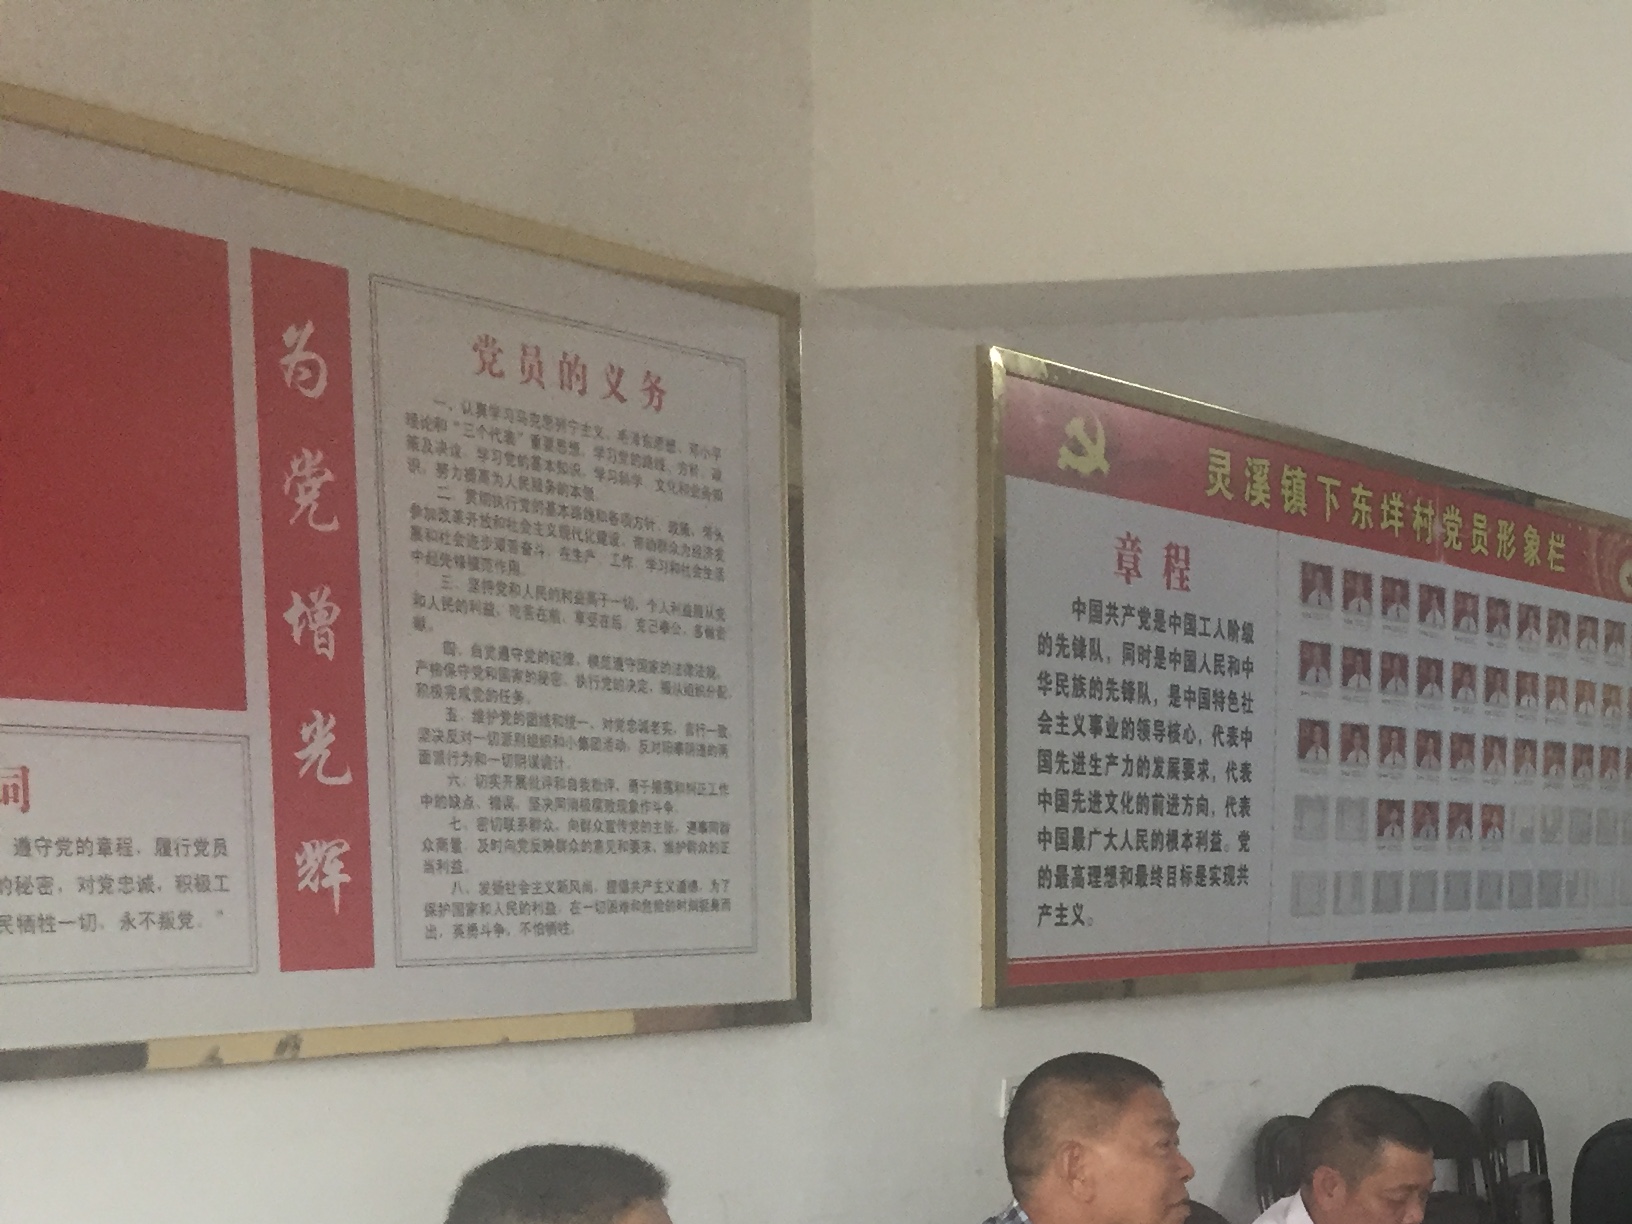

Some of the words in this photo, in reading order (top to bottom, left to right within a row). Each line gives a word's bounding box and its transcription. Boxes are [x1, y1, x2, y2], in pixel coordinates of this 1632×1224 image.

[472, 333, 667, 414] 党员的义务
[1204, 447, 1567, 574] 灵溪镇下东垟村党员形象栏
[1113, 530, 1192, 592] 章程
[279, 319, 353, 915] 为党增光辉
[1071, 596, 1254, 645] 中国共产党是中国工人阶级
[1037, 864, 1250, 889] 的最高理想和最终目标是实现共
